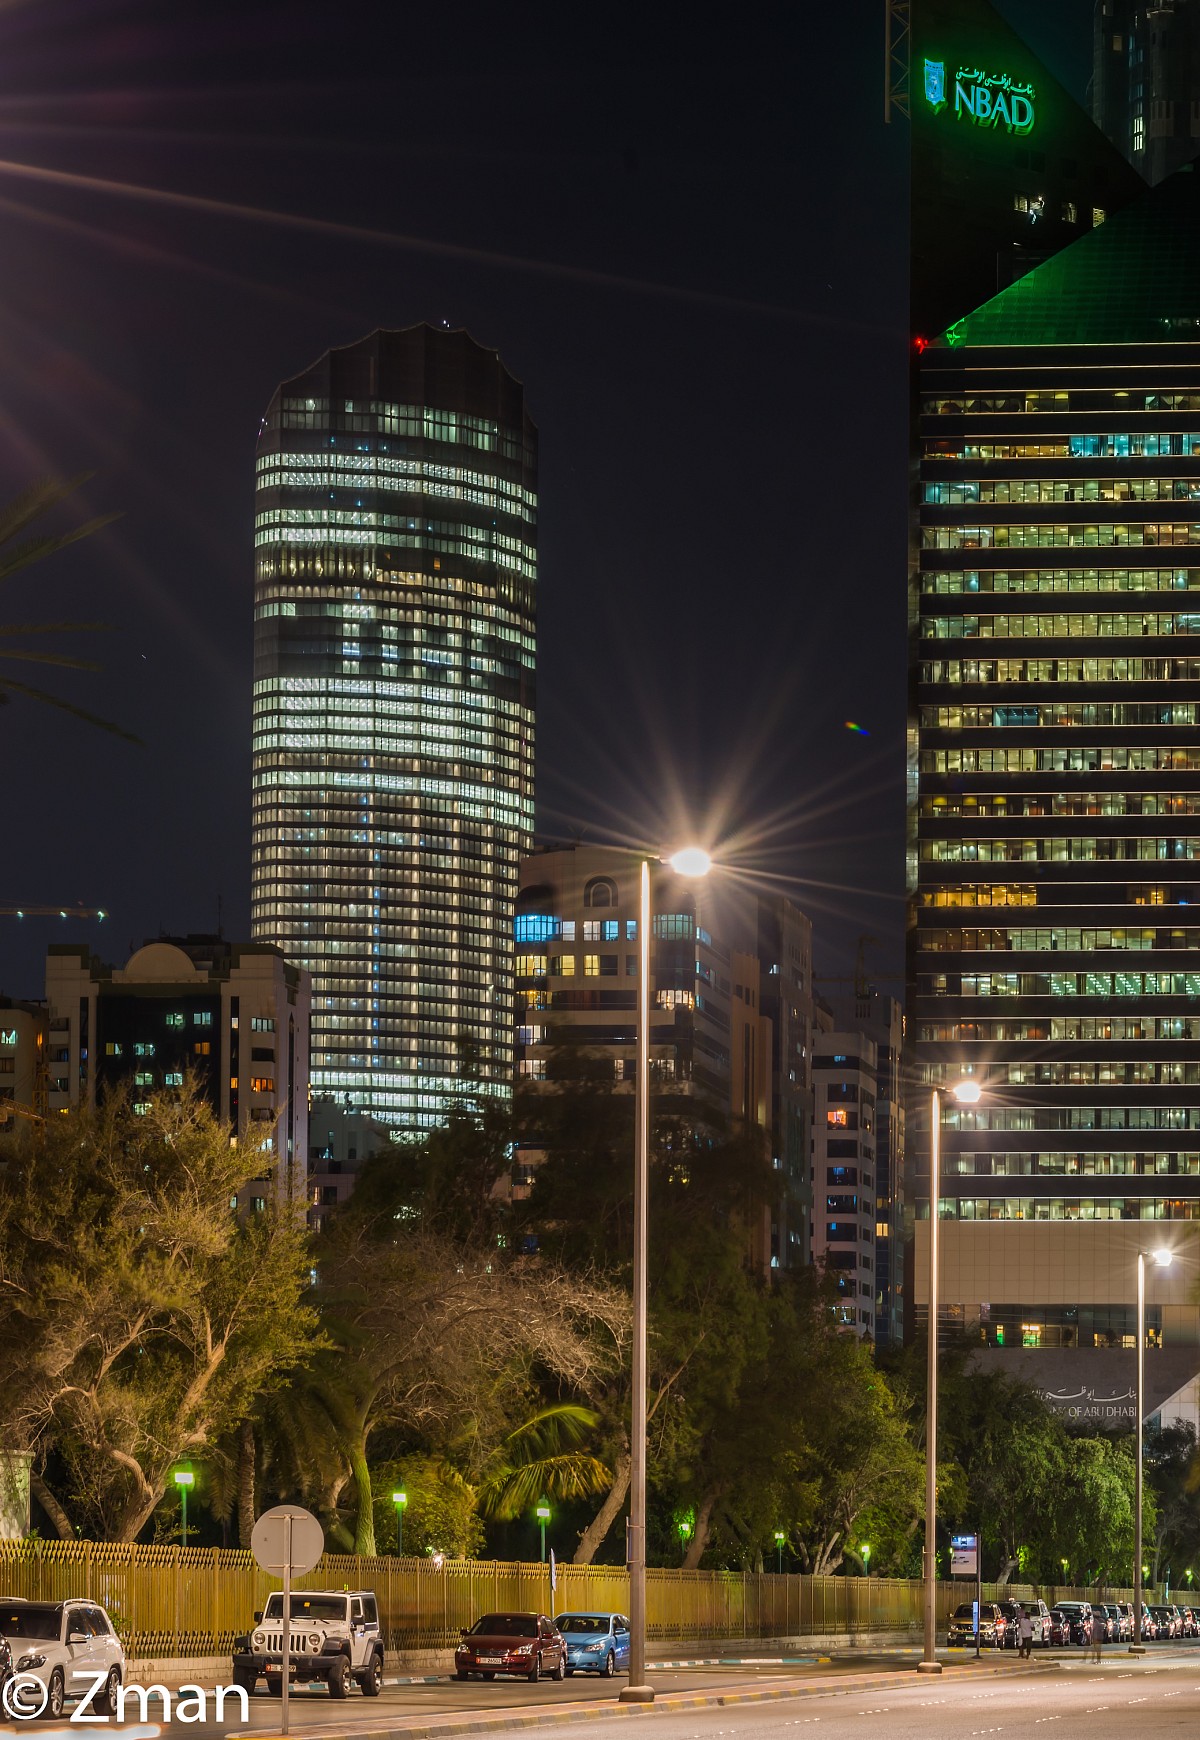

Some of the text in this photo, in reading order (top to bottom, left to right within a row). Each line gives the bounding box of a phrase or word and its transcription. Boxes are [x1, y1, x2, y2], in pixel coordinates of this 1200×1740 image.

[955, 81, 1033, 128] NBAD
[1068, 1406, 1082, 1417] OF
[1084, 1406, 1104, 1417] ABU
[1106, 1406, 1137, 1417] DHABI
